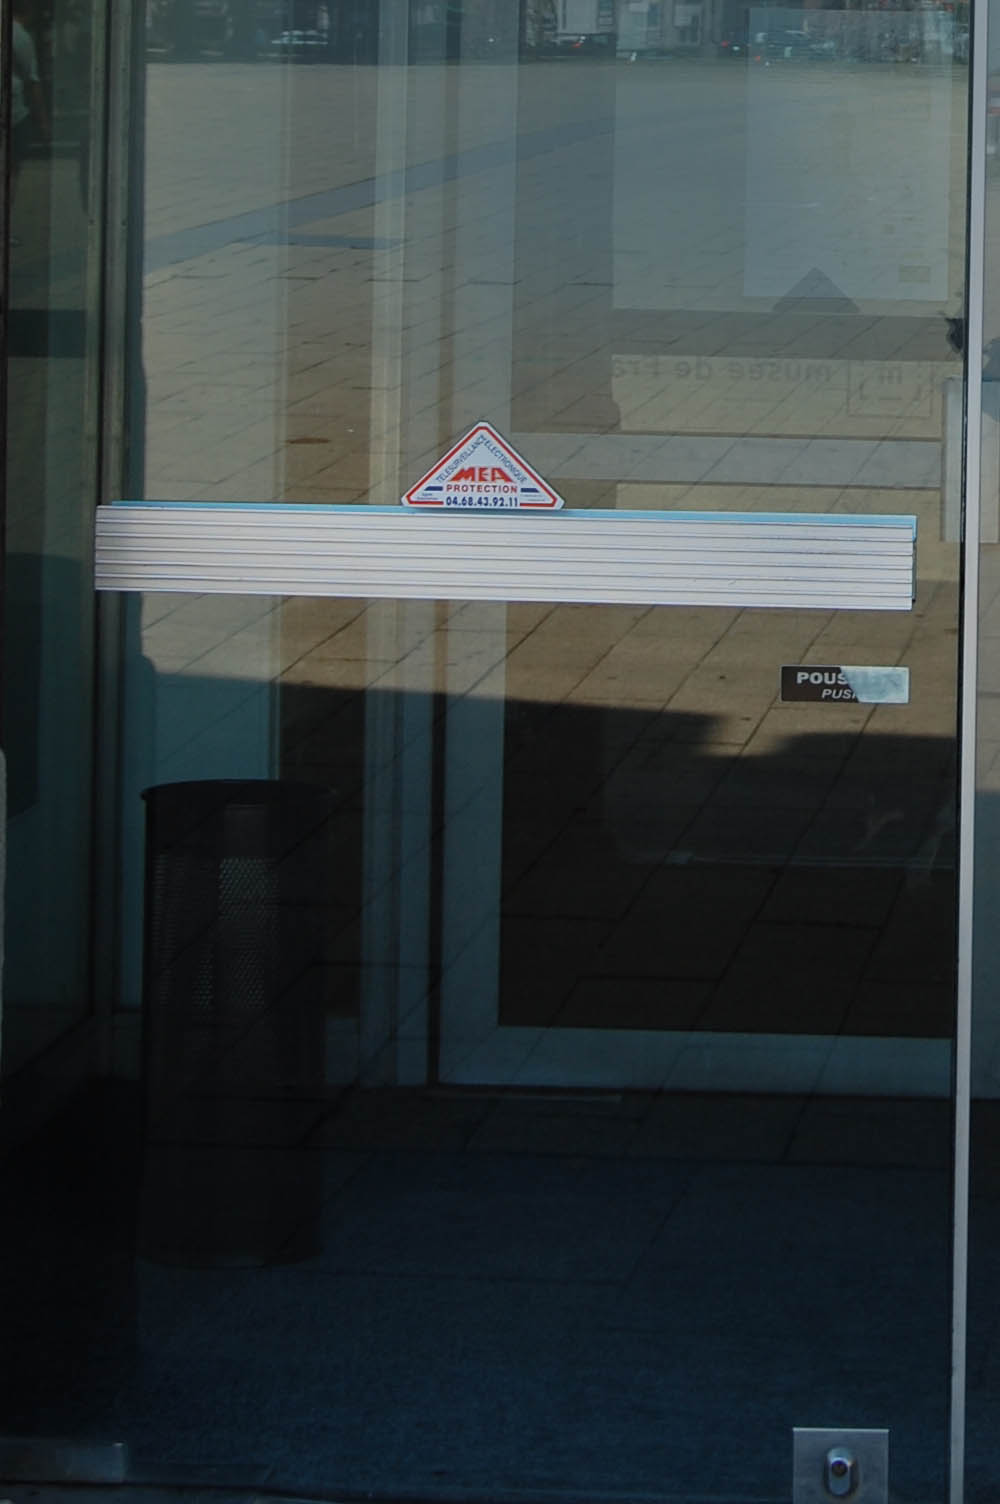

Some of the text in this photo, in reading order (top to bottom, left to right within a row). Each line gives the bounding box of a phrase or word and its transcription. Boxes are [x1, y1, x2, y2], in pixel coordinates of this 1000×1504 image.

[447, 466, 516, 483] MEA
[446, 483, 518, 494] PROTECTION
[446, 495, 518, 508] 04.68.43.92.11
[796, 671, 850, 686] POUS
